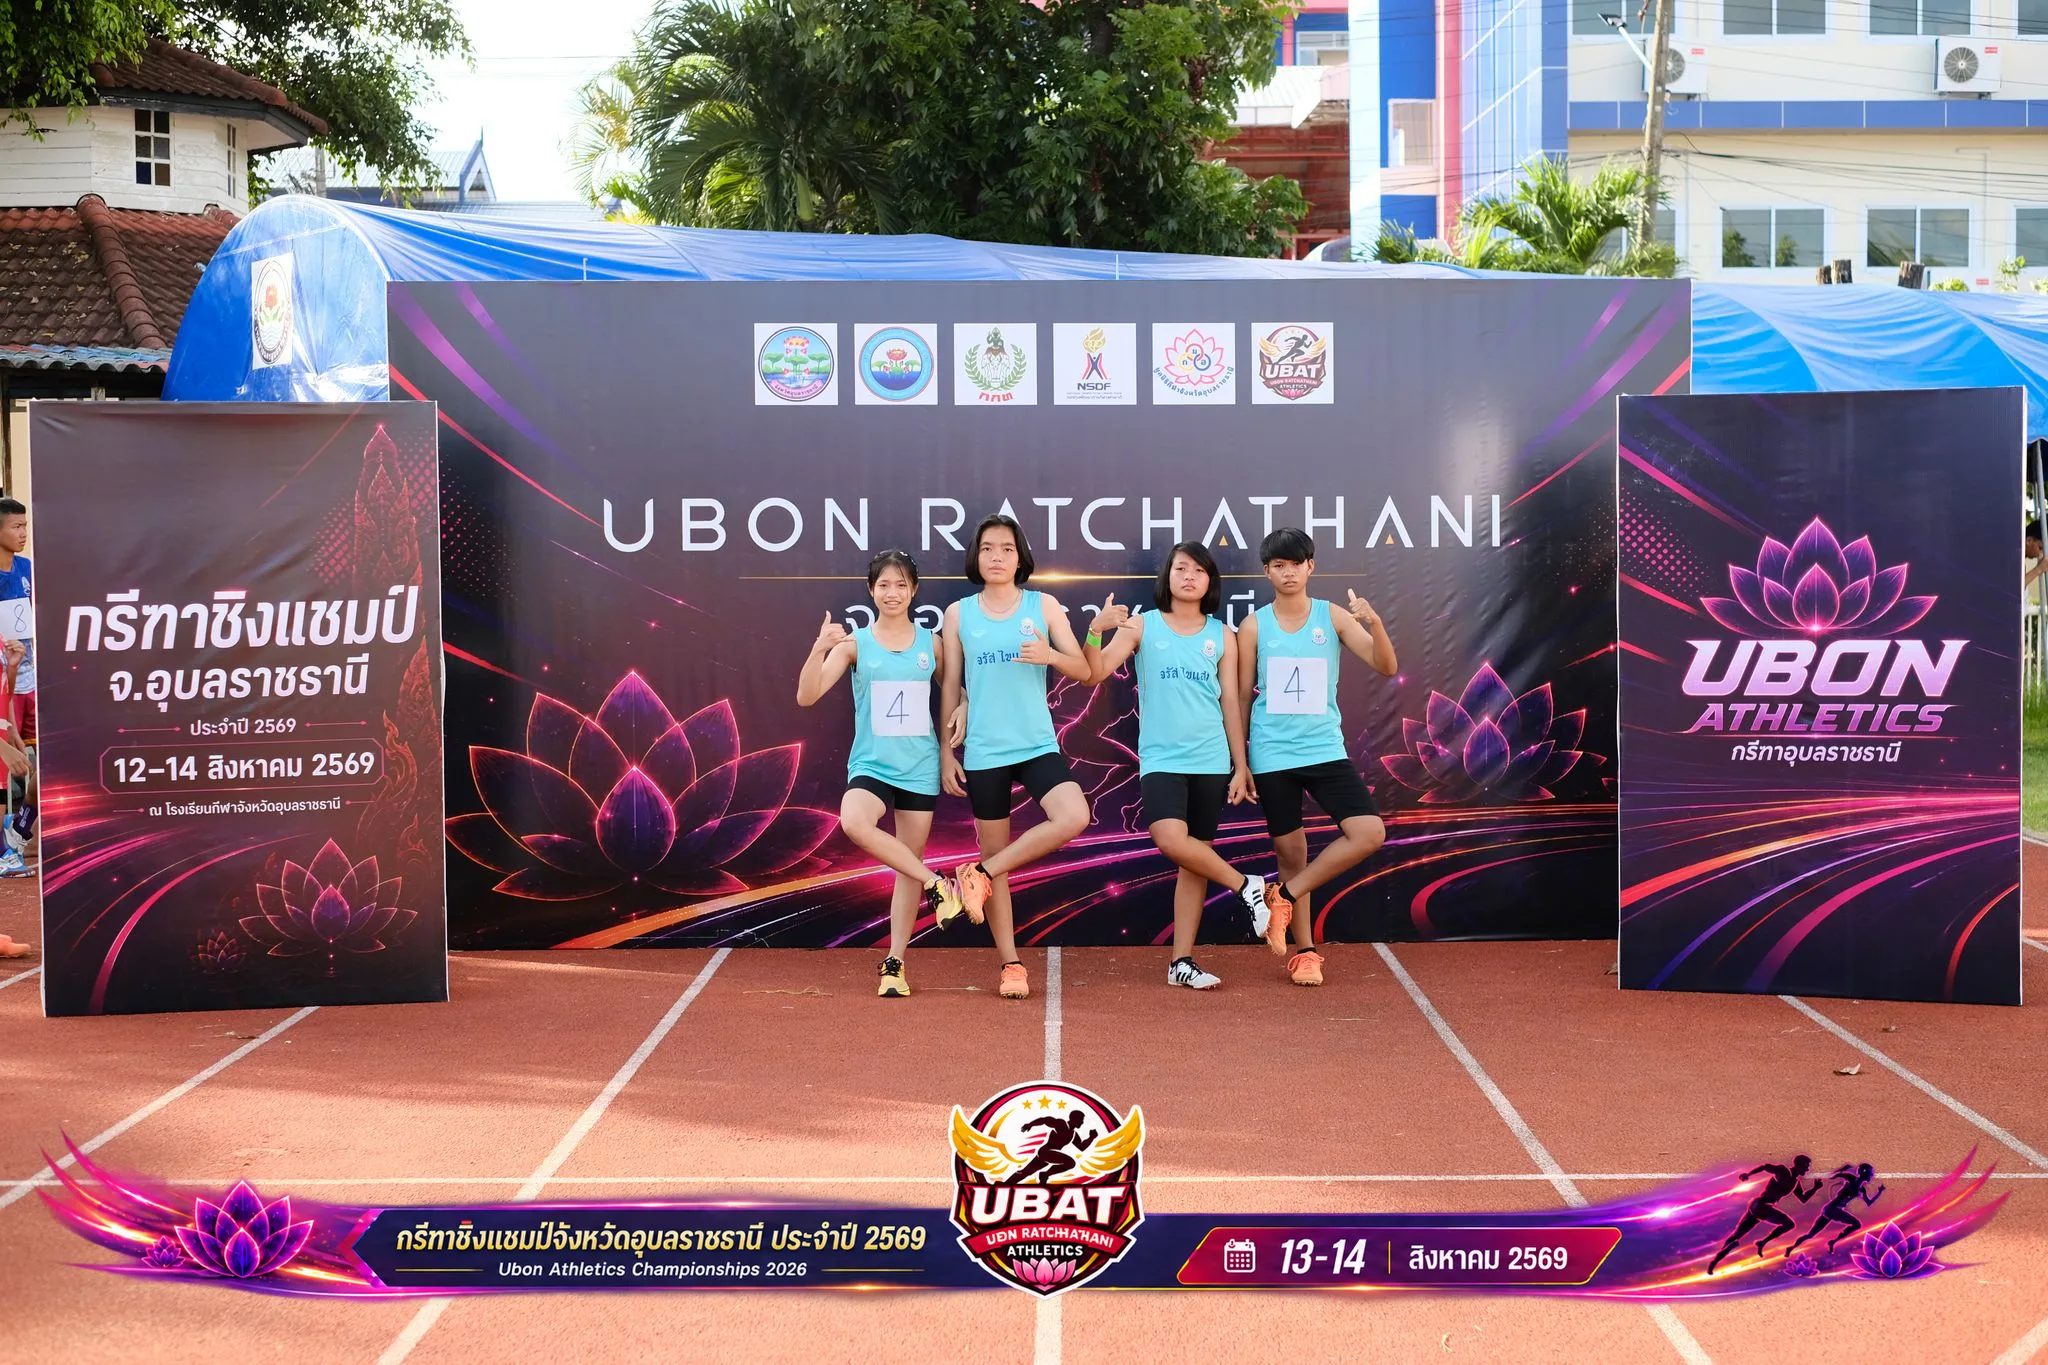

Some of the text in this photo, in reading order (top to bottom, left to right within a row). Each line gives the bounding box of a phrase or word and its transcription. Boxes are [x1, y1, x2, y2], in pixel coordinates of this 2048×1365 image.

[1265, 364, 1321, 378] UBAT
[1077, 382, 1111, 391] NSDF
[603, 497, 869, 552] UBON
[13, 603, 27, 633] 8
[65, 584, 419, 652] กรีฑาชิงแชมป์
[109, 652, 370, 713] จ.อุบลราชธานี
[1681, 638, 1971, 697] UBON
[1283, 665, 1306, 703] 4
[886, 690, 910, 724] 4
[1675, 703, 1960, 734] ATHLETICS
[190, 718, 297, 736] ประจำปี 2569
[207, 754, 303, 780] สิงหาคม
[311, 751, 375, 777] 2569
[1731, 740, 1902, 767] กรีฑาอุบลราชธานี
[149, 796, 341, 816] ณ โรงเรียนกีฬาจังหวัดอุบลราชธานี
